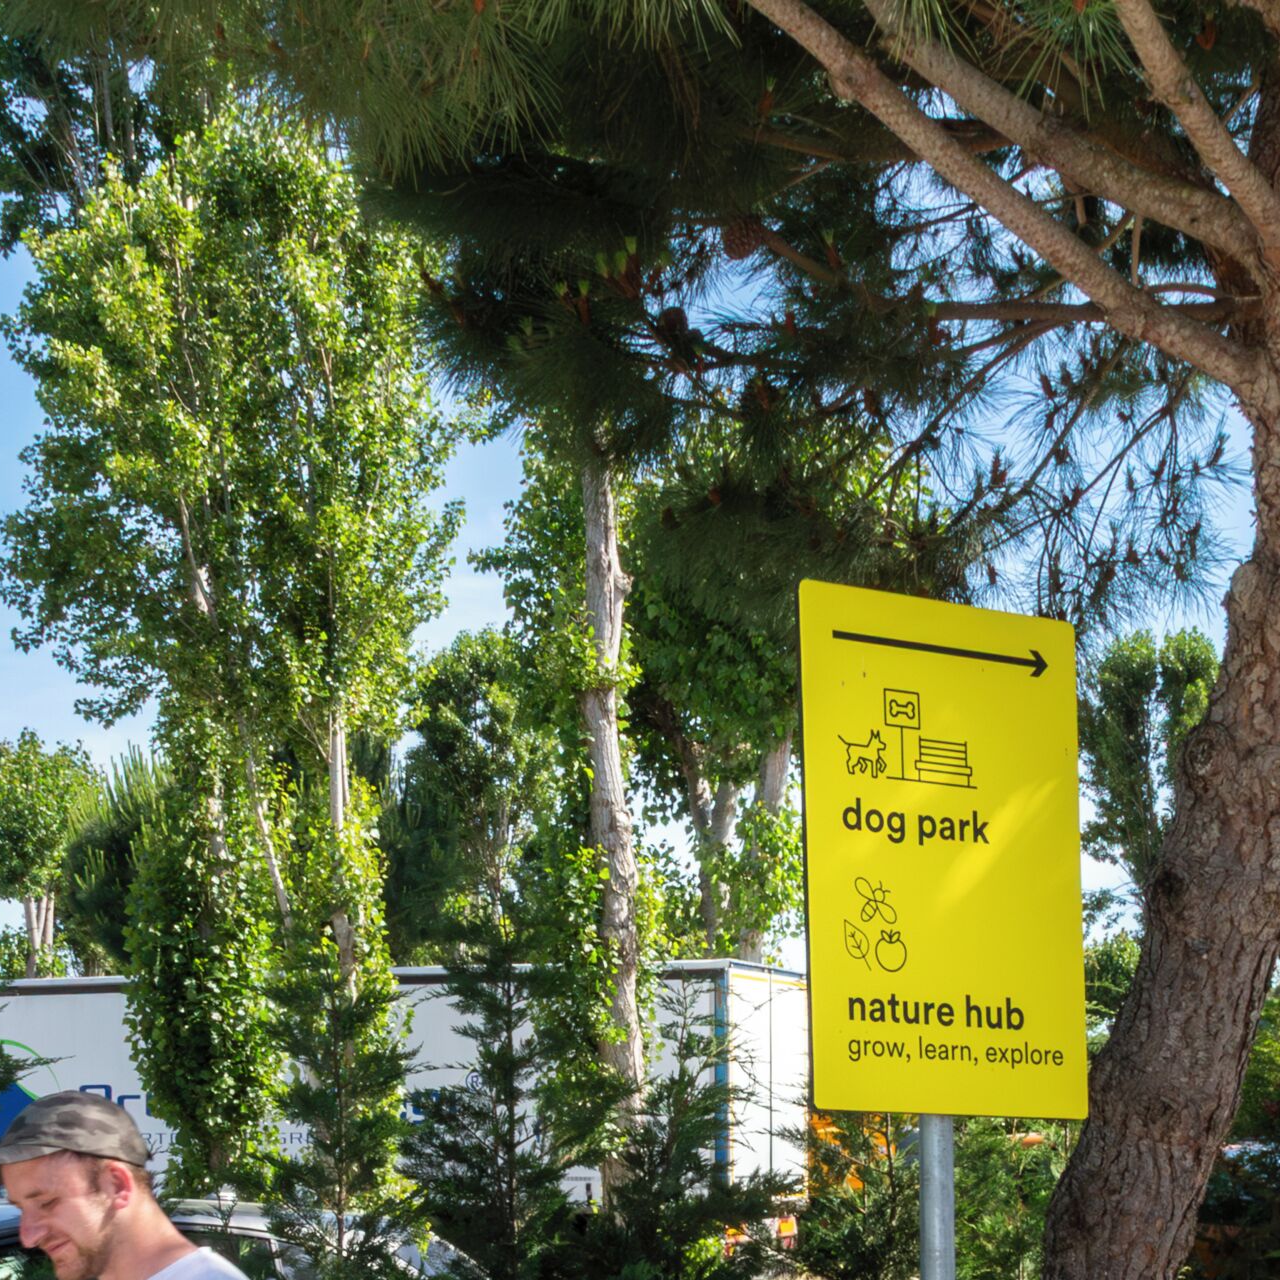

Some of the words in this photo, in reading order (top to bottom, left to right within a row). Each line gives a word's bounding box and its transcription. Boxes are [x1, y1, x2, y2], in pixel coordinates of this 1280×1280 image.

[842, 797, 906, 844] dog
[917, 810, 989, 846] park
[848, 993, 955, 1027] nature
[965, 994, 1025, 1031] hub
[848, 1039, 911, 1062] grow,
[918, 1035, 978, 1066] learn,
[985, 1041, 1064, 1070] explore
